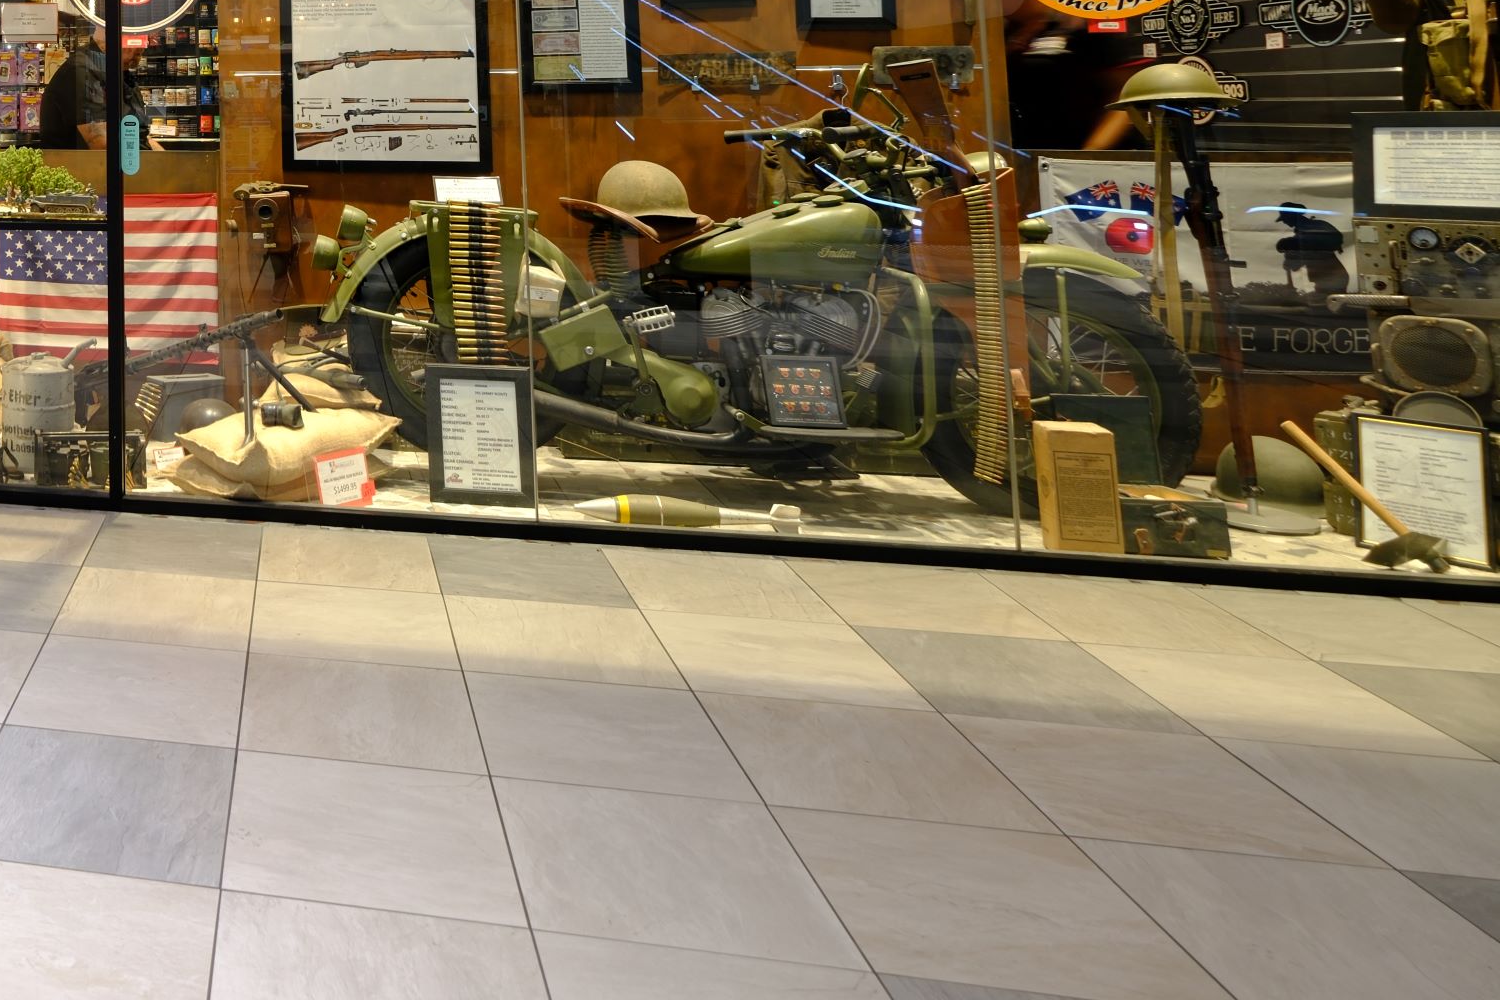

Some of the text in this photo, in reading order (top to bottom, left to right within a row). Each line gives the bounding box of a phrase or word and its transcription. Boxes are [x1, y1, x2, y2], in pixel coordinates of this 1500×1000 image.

[1213, 10, 1235, 24] HERE
[1304, 2, 1338, 20] Mack
[1143, 17, 1166, 32] SERVED
[8, 388, 41, 407] Ether
